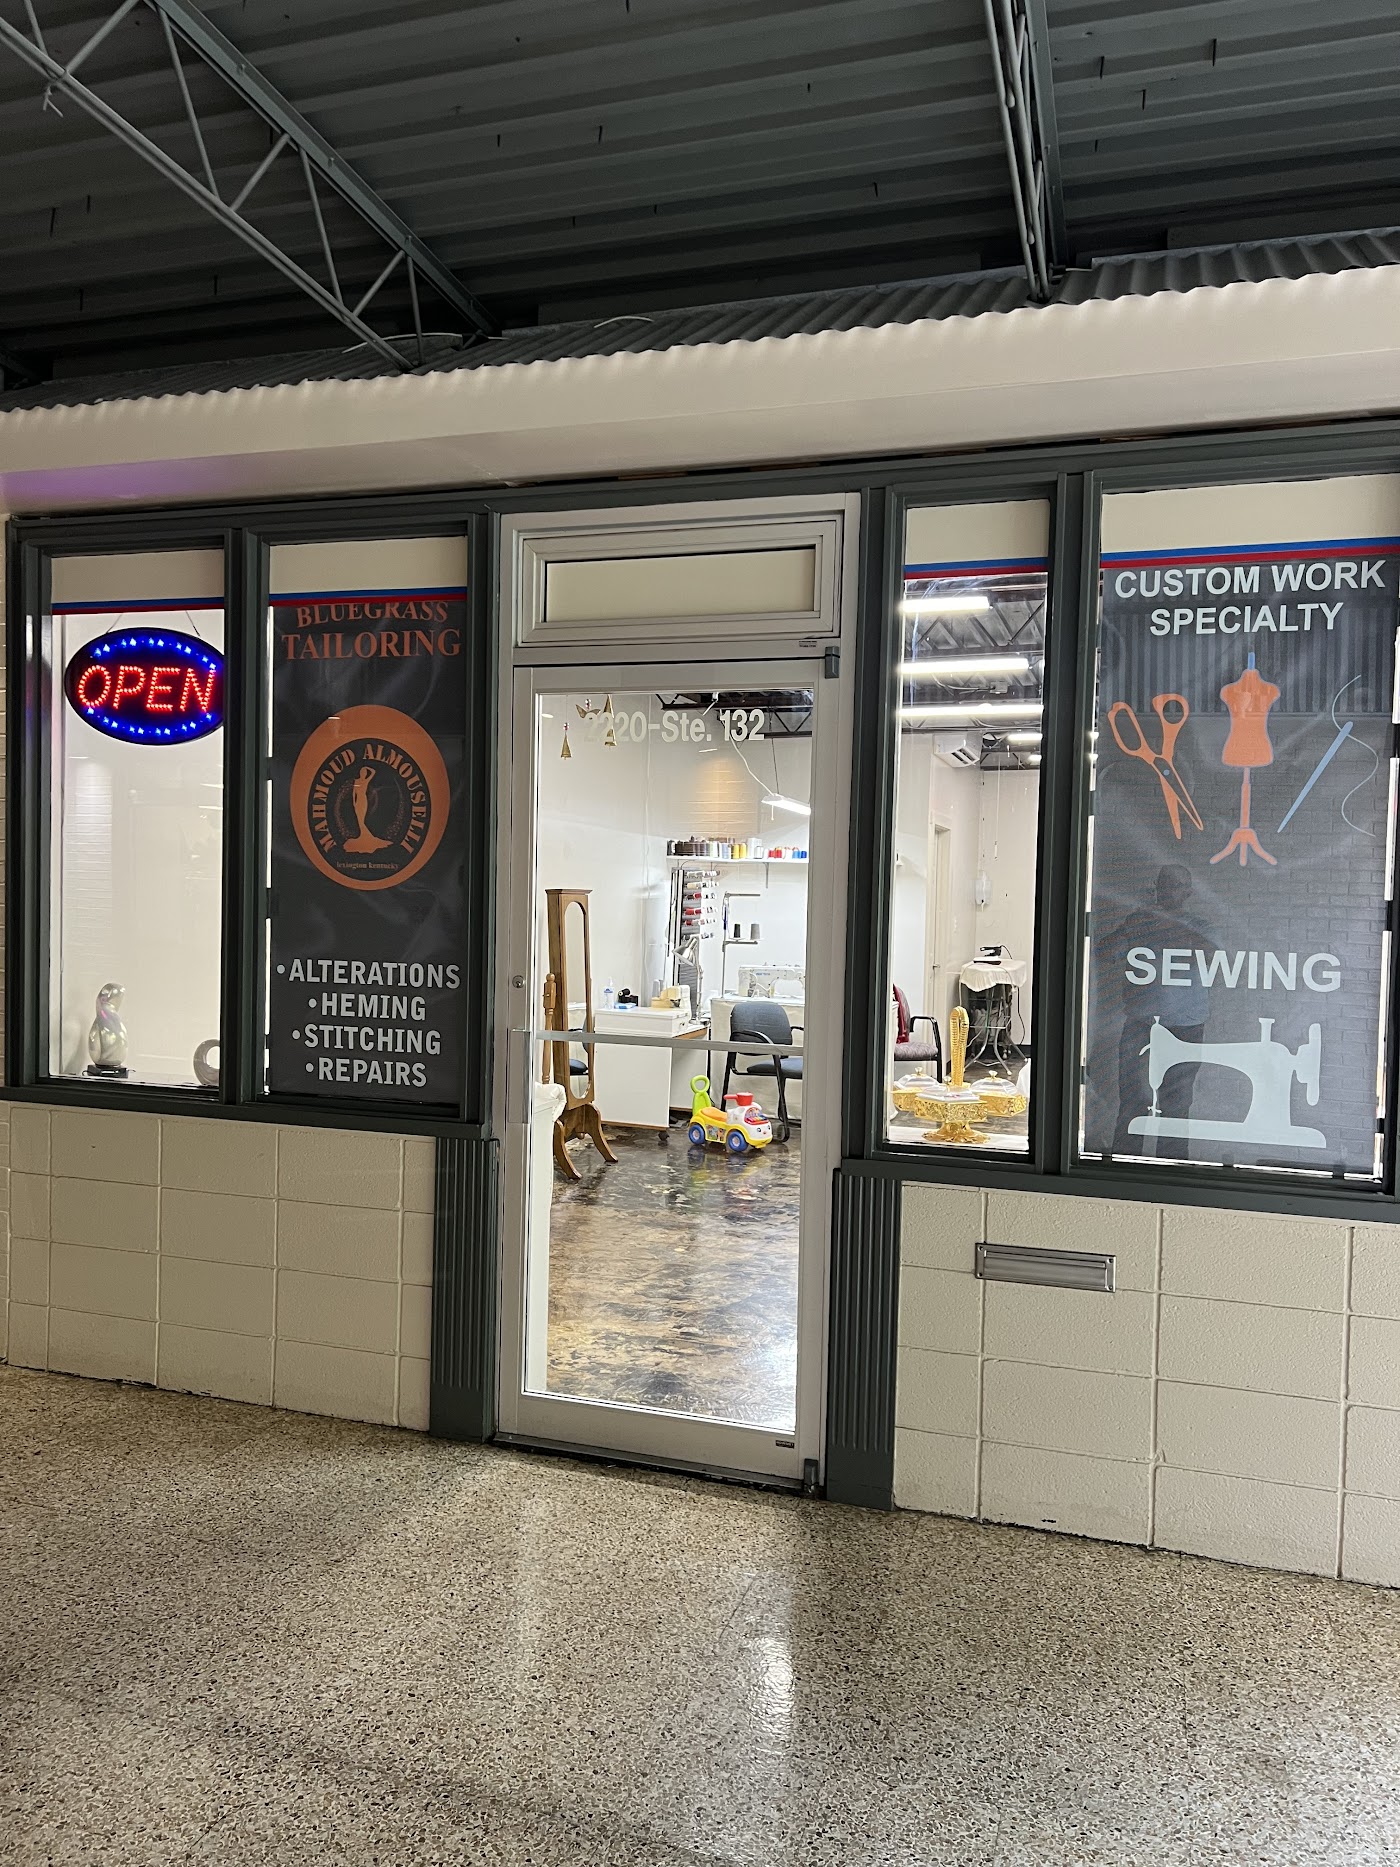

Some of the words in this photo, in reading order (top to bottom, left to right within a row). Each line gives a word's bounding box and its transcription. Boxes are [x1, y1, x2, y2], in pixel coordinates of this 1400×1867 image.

[1114, 566, 1260, 598] CUSTOM
[1271, 560, 1387, 592] WORK
[296, 601, 449, 628] BLUEGRASS
[1150, 602, 1344, 636] SPECIALTY
[281, 629, 462, 660] TAILORING
[77, 664, 216, 712] OPEN
[719, 708, 765, 742] 132
[312, 749, 356, 853] MAHMOUD
[1125, 946, 1341, 993] SEWING
